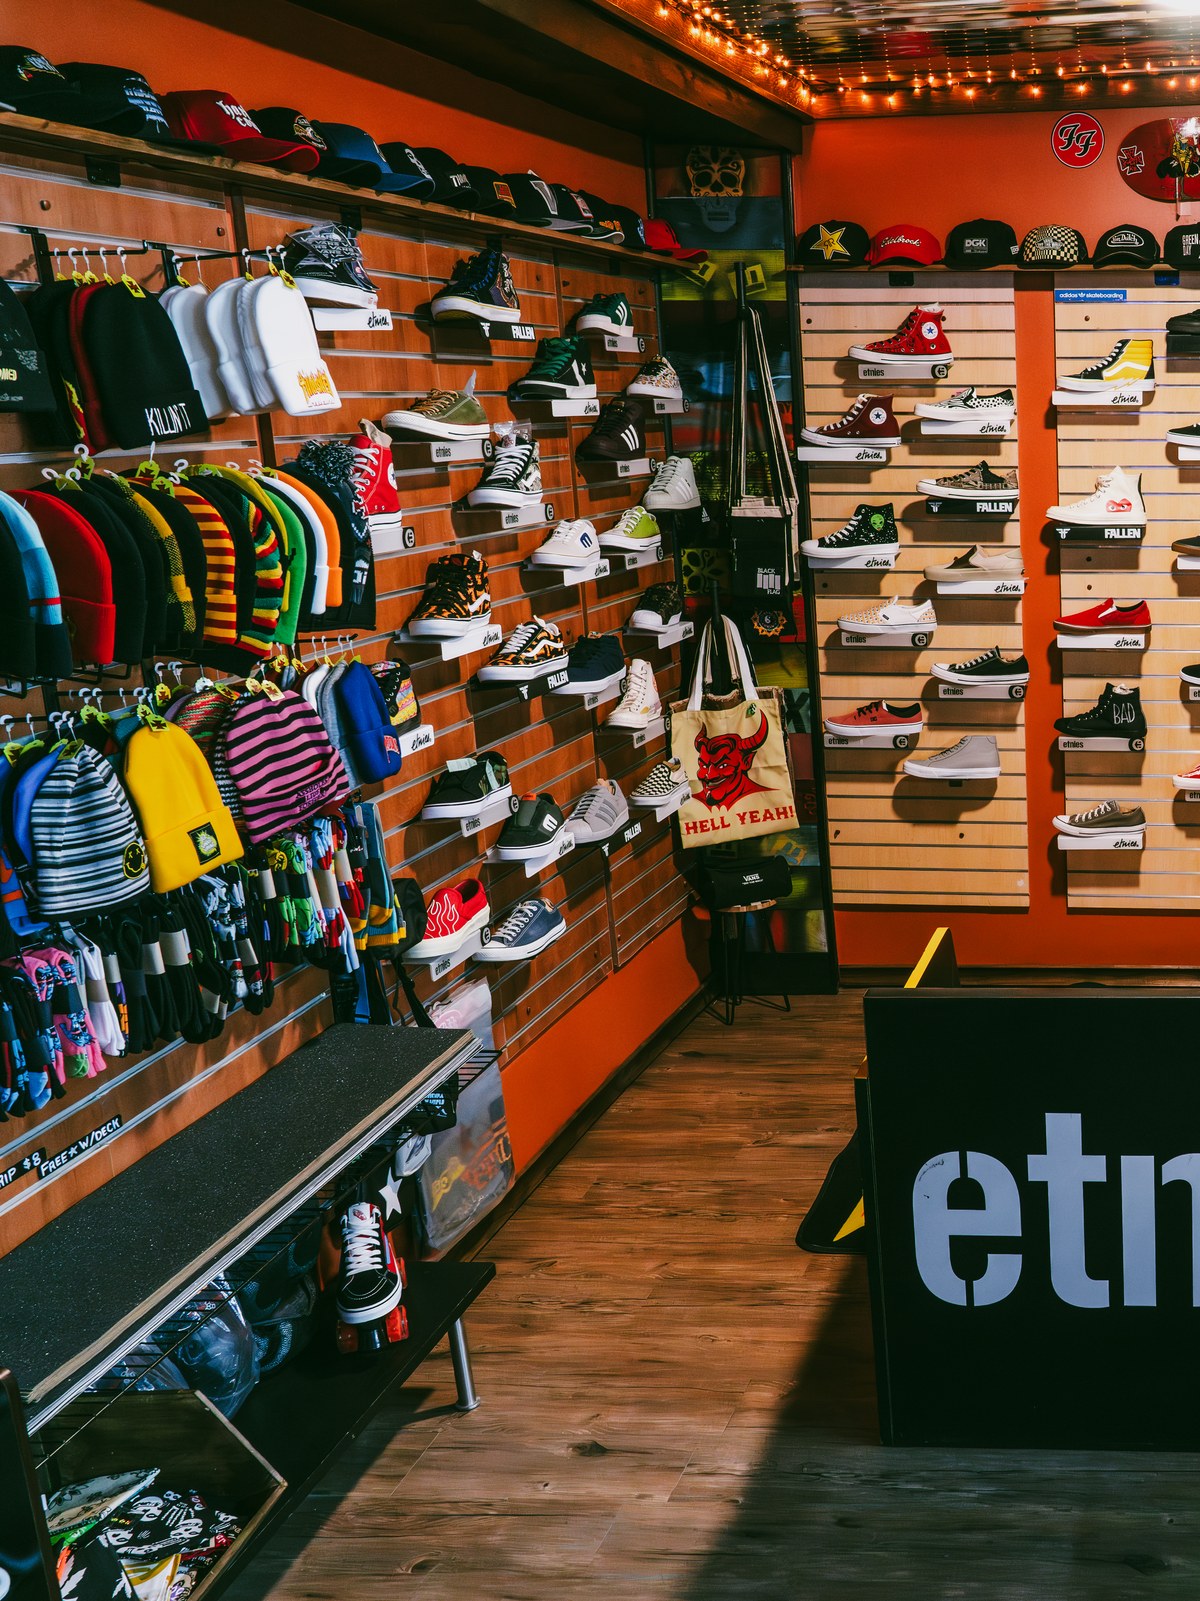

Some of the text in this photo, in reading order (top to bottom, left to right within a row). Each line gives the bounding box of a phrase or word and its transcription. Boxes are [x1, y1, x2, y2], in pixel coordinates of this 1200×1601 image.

[880, 235, 922, 248] Edelbrock
[965, 238, 986, 248] DGK
[1182, 233, 1199, 245] GREEN
[1183, 244, 1192, 256] DAY
[1085, 292, 1124, 300] skateboarding
[511, 325, 535, 340] FALLEN
[863, 368, 885, 377] etnies
[436, 446, 451, 458] etnies
[976, 502, 1013, 513] FALLEN
[505, 512, 519, 525] etnies
[1104, 528, 1141, 539] FALLEN
[845, 635, 867, 644] etnies
[547, 669, 569, 690] FALLEN
[943, 687, 964, 696] etnies
[1112, 703, 1136, 725] BAD
[828, 736, 849, 745] etnies
[1062, 740, 1084, 749] etnies
[465, 816, 481, 831] etnies
[684, 805, 795, 836] HELL YEAH!
[624, 822, 642, 842] FALLEN
[743, 873, 760, 882] VANS
[435, 957, 451, 976] etnies
[22, 1152, 42, 1170] $8
